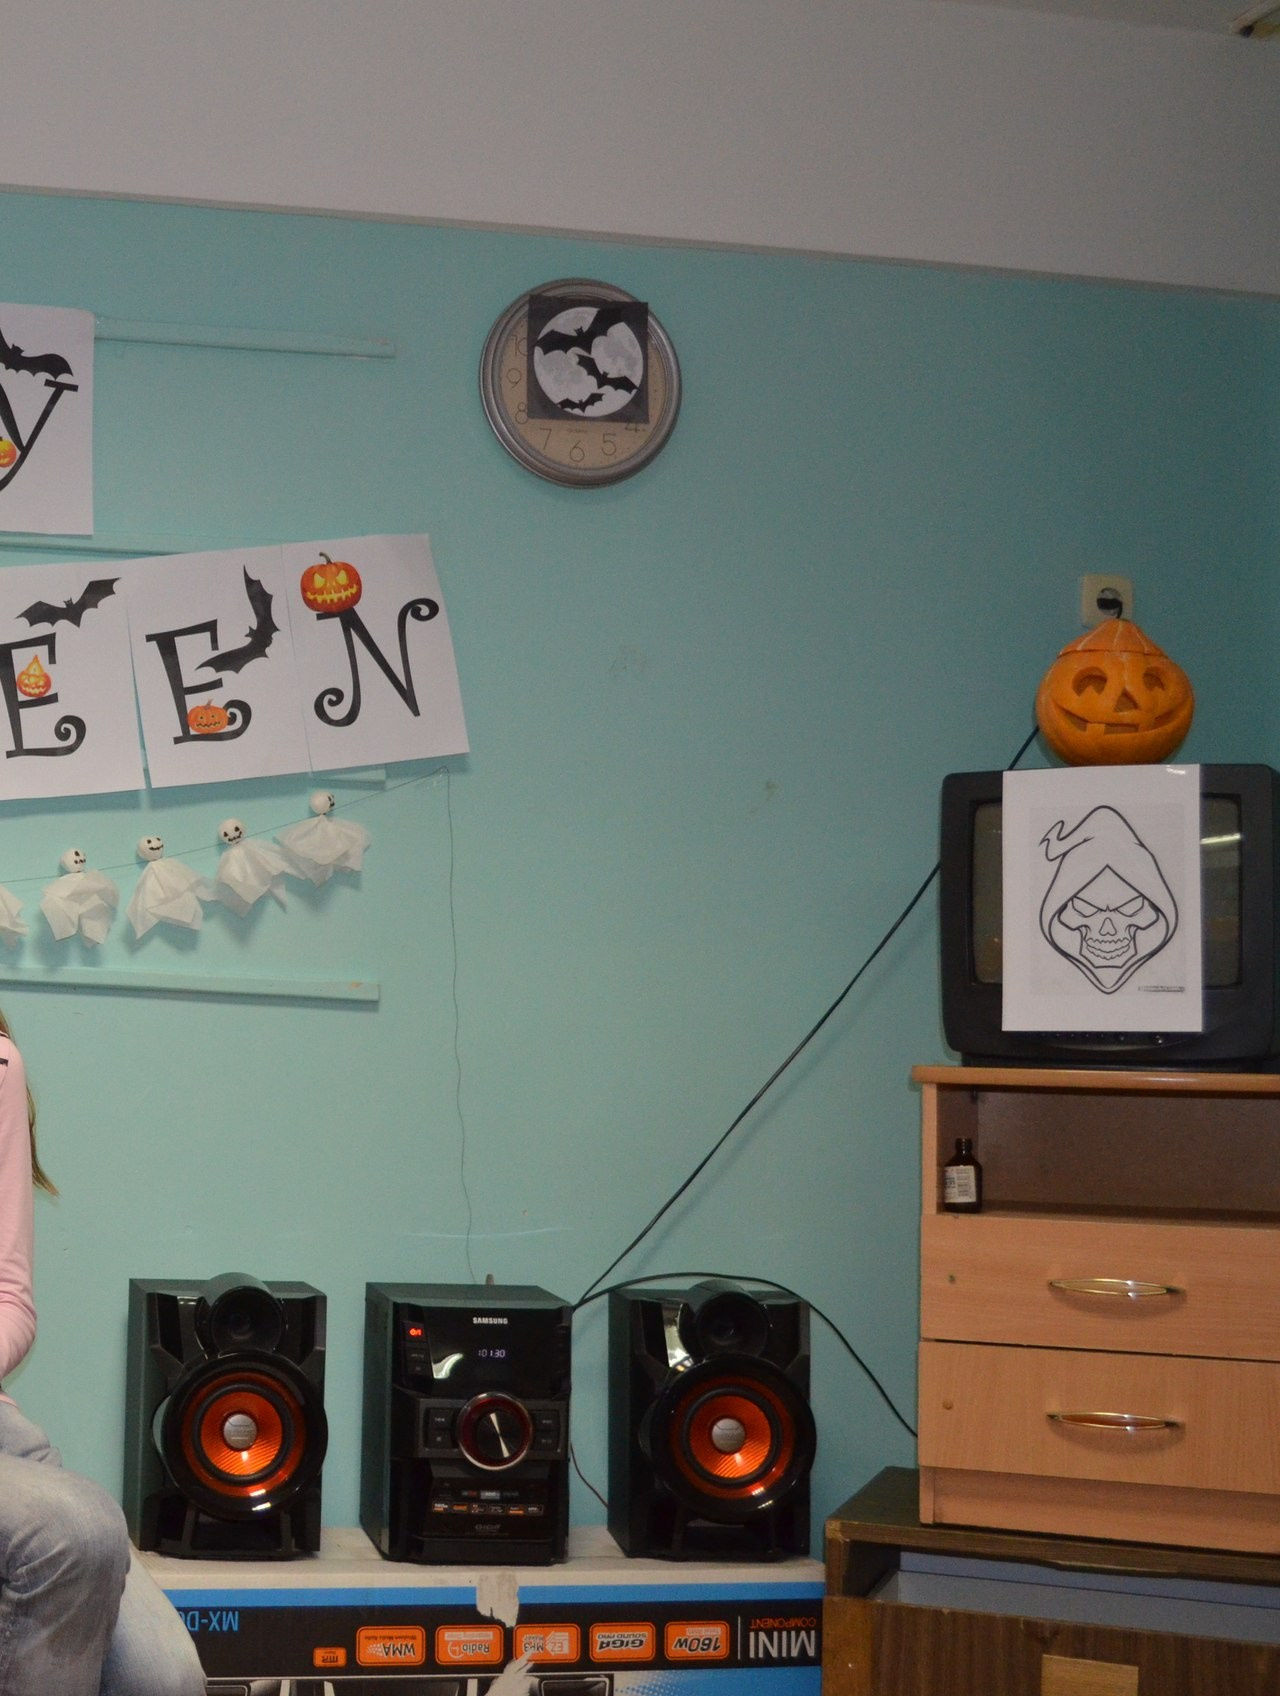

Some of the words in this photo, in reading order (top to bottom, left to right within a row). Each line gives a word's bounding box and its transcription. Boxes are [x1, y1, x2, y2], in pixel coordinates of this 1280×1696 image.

[505, 367, 522, 390] 9
[514, 403, 528, 425] 8
[539, 428, 553, 450] 7
[601, 433, 617, 457] 5
[569, 440, 586, 463] 6
[472, 1316, 509, 1325] SAMSUNG
[749, 1616, 817, 1629] COMPONENT
[597, 1632, 617, 1640] PRO
[617, 1632, 648, 1640] SOUND
[749, 1629, 816, 1659] MINI
[382, 1641, 416, 1657] WMA
[461, 1642, 490, 1654] Radio
[597, 1638, 645, 1651] GIGA
